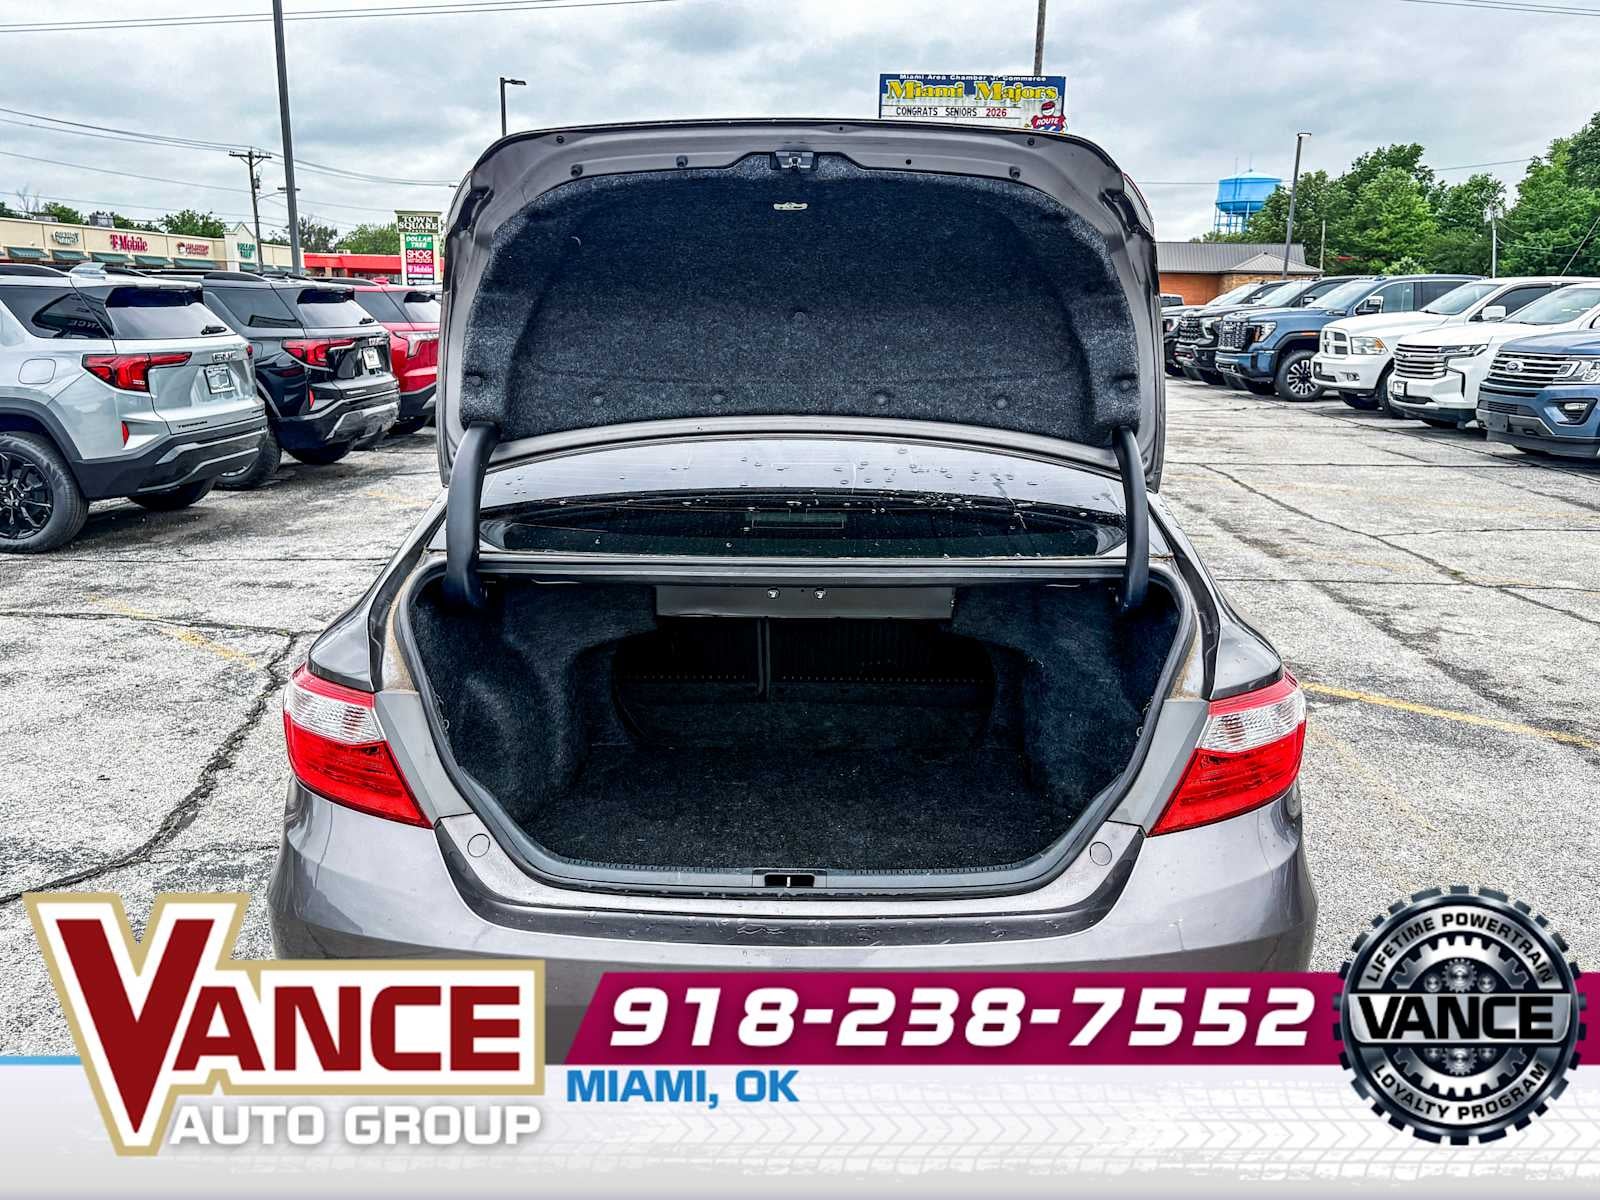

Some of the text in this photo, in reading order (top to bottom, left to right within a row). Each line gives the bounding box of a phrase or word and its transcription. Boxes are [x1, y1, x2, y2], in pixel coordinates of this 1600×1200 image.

[887, 80, 1058, 102] Miami Majors
[896, 107, 1007, 117] CONGRATS SENIORS 2026
[1036, 118, 1059, 126] ROUTE
[399, 222, 438, 230] SQUARE
